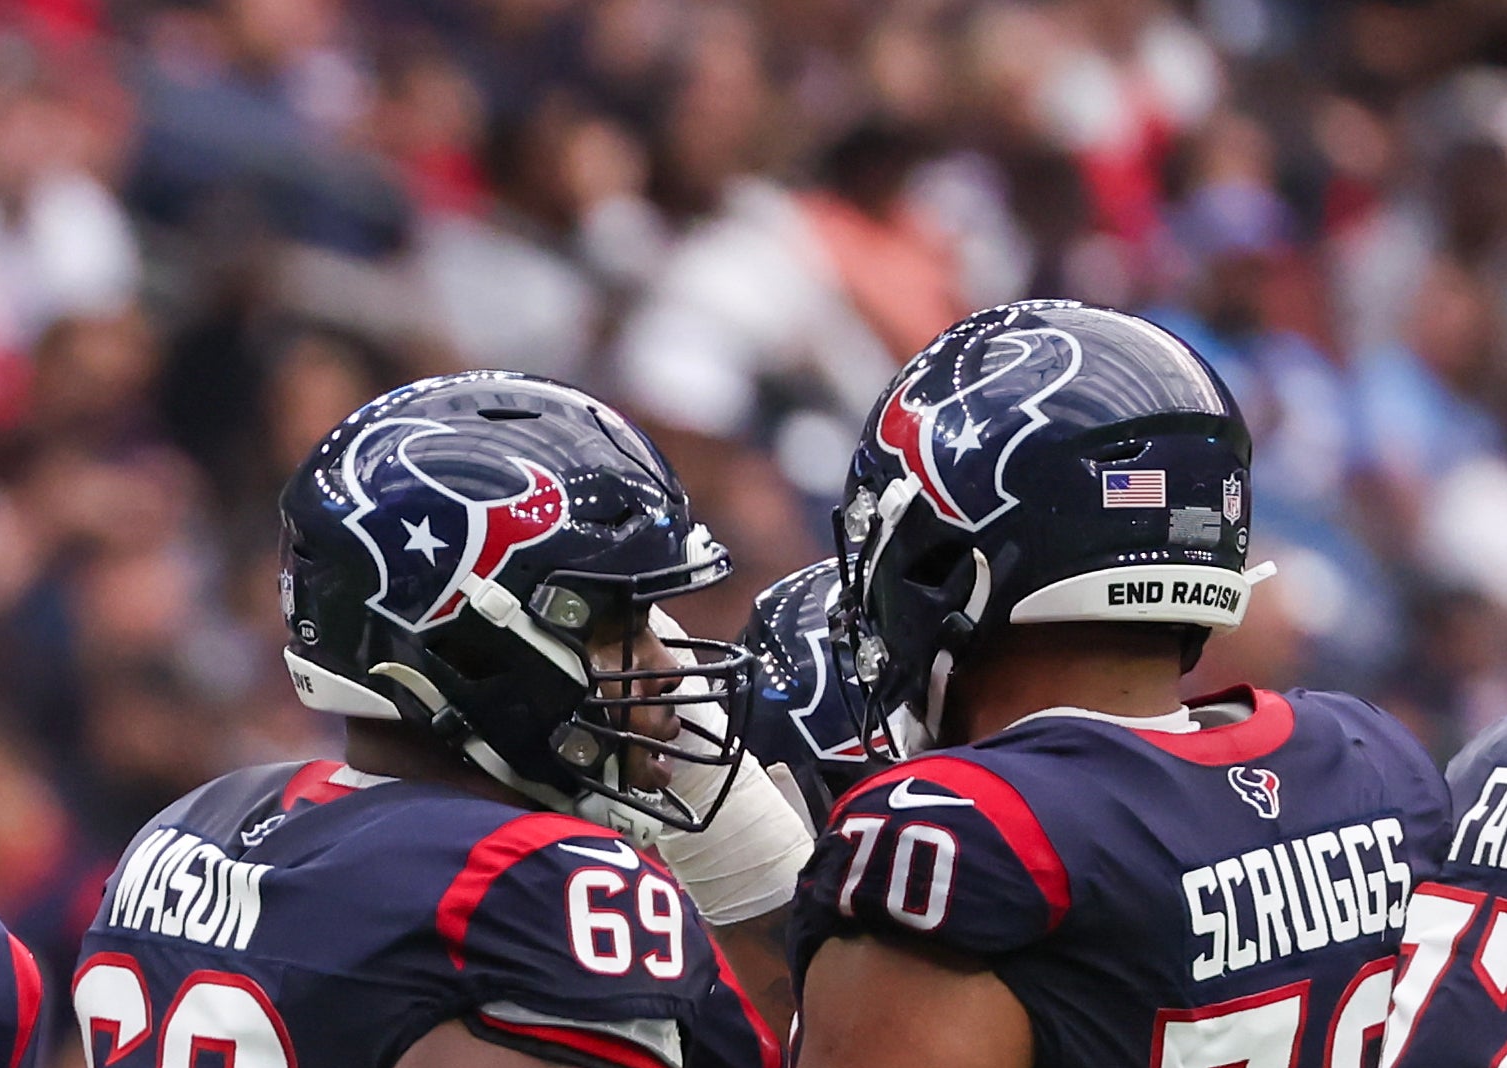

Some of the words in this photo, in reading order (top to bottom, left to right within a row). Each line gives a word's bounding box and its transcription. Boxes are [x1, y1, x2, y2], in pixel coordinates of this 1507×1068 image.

[1108, 581, 1164, 606] END
[1171, 581, 1241, 614] RACISM
[108, 826, 274, 951] MASON
[563, 865, 685, 980] 69
[838, 814, 959, 931] 70
[1182, 817, 1411, 982] SCRUGGS
